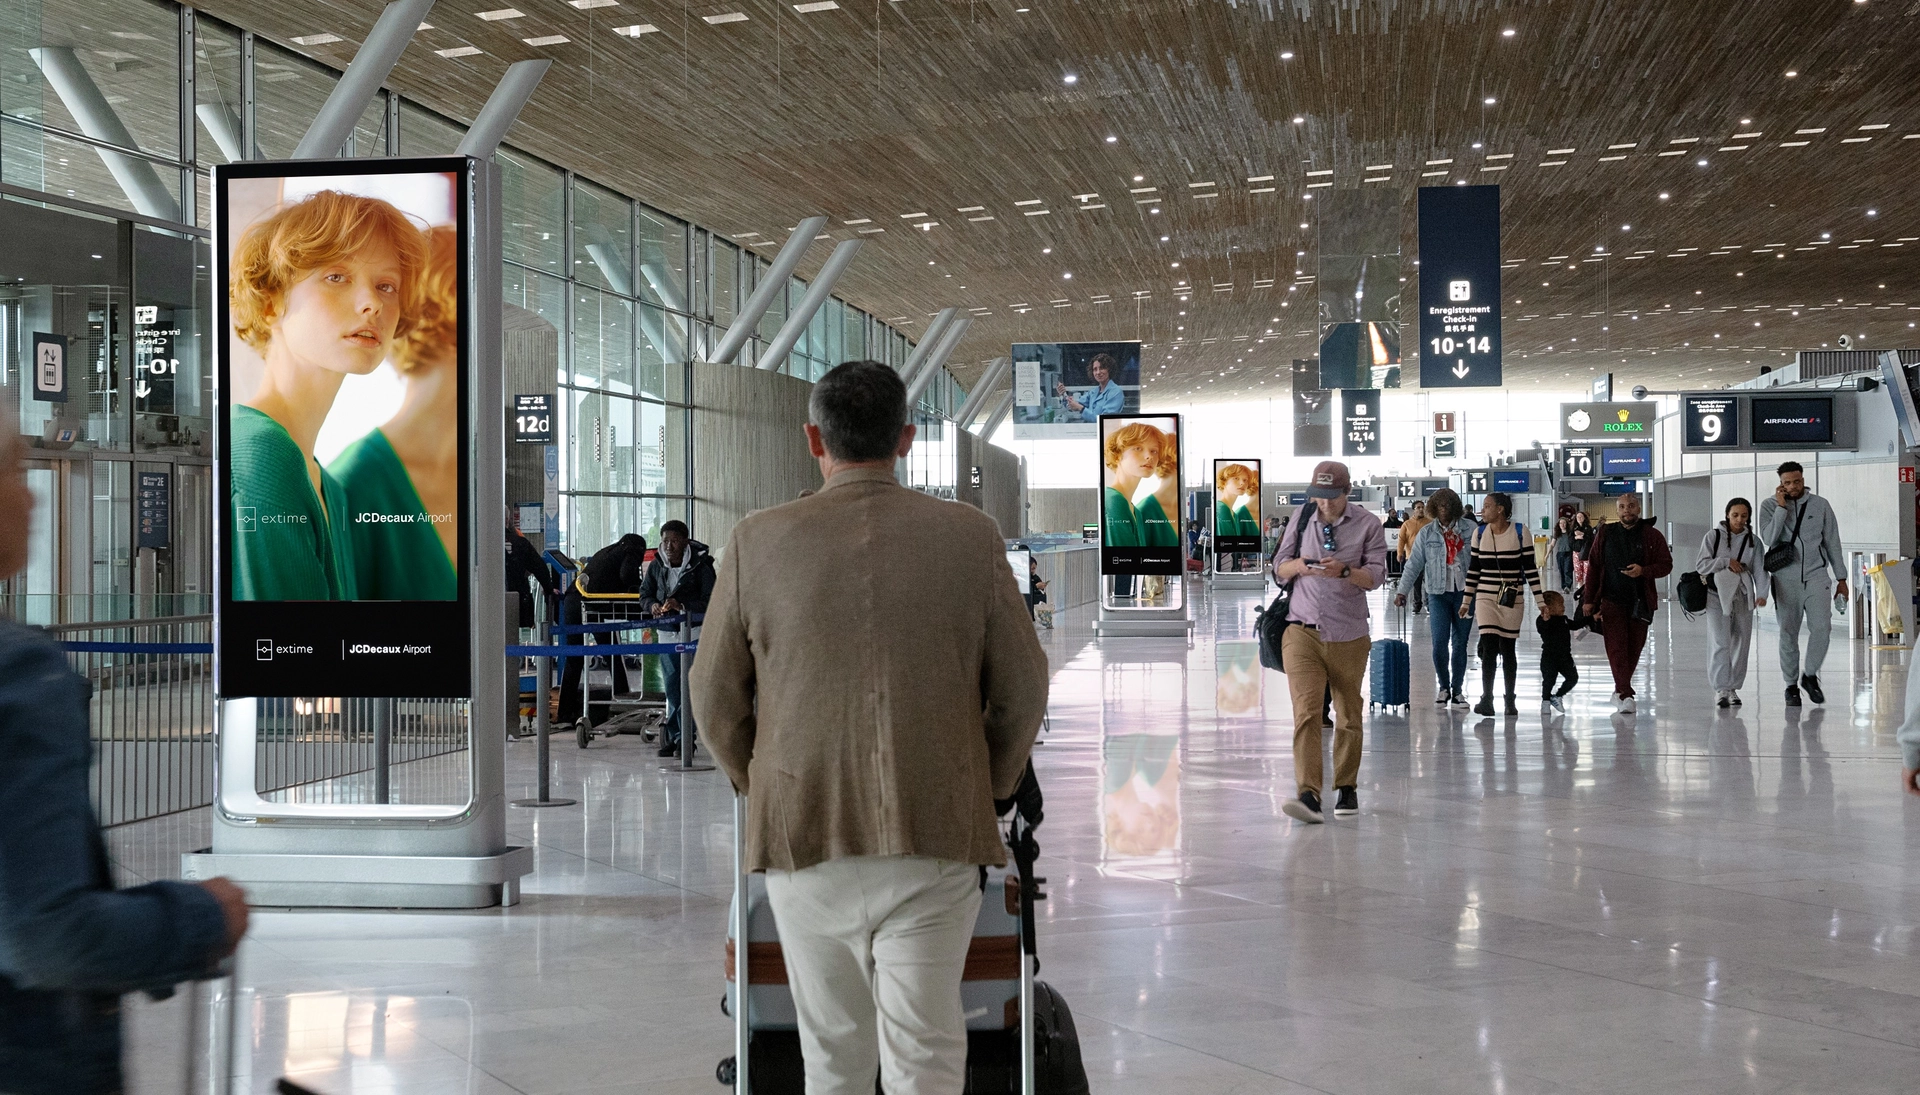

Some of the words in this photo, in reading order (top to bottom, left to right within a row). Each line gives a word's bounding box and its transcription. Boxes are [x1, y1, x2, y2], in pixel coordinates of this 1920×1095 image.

[1429, 305, 1491, 315] Enregistrement
[1442, 315, 1477, 323] Check-in
[516, 414, 550, 433] 12d
[1603, 422, 1643, 432] ROLEX
[1701, 414, 1722, 442] 9
[1565, 456, 1592, 475] 10
[1470, 478, 1487, 491] 11
[1400, 486, 1415, 497] 12
[260, 511, 308, 524] extime
[354, 512, 414, 523] JCDecaux
[416, 512, 453, 525] Airport
[275, 643, 314, 654] extime
[349, 644, 401, 654] JCDecaux
[402, 644, 432, 656] Airport
